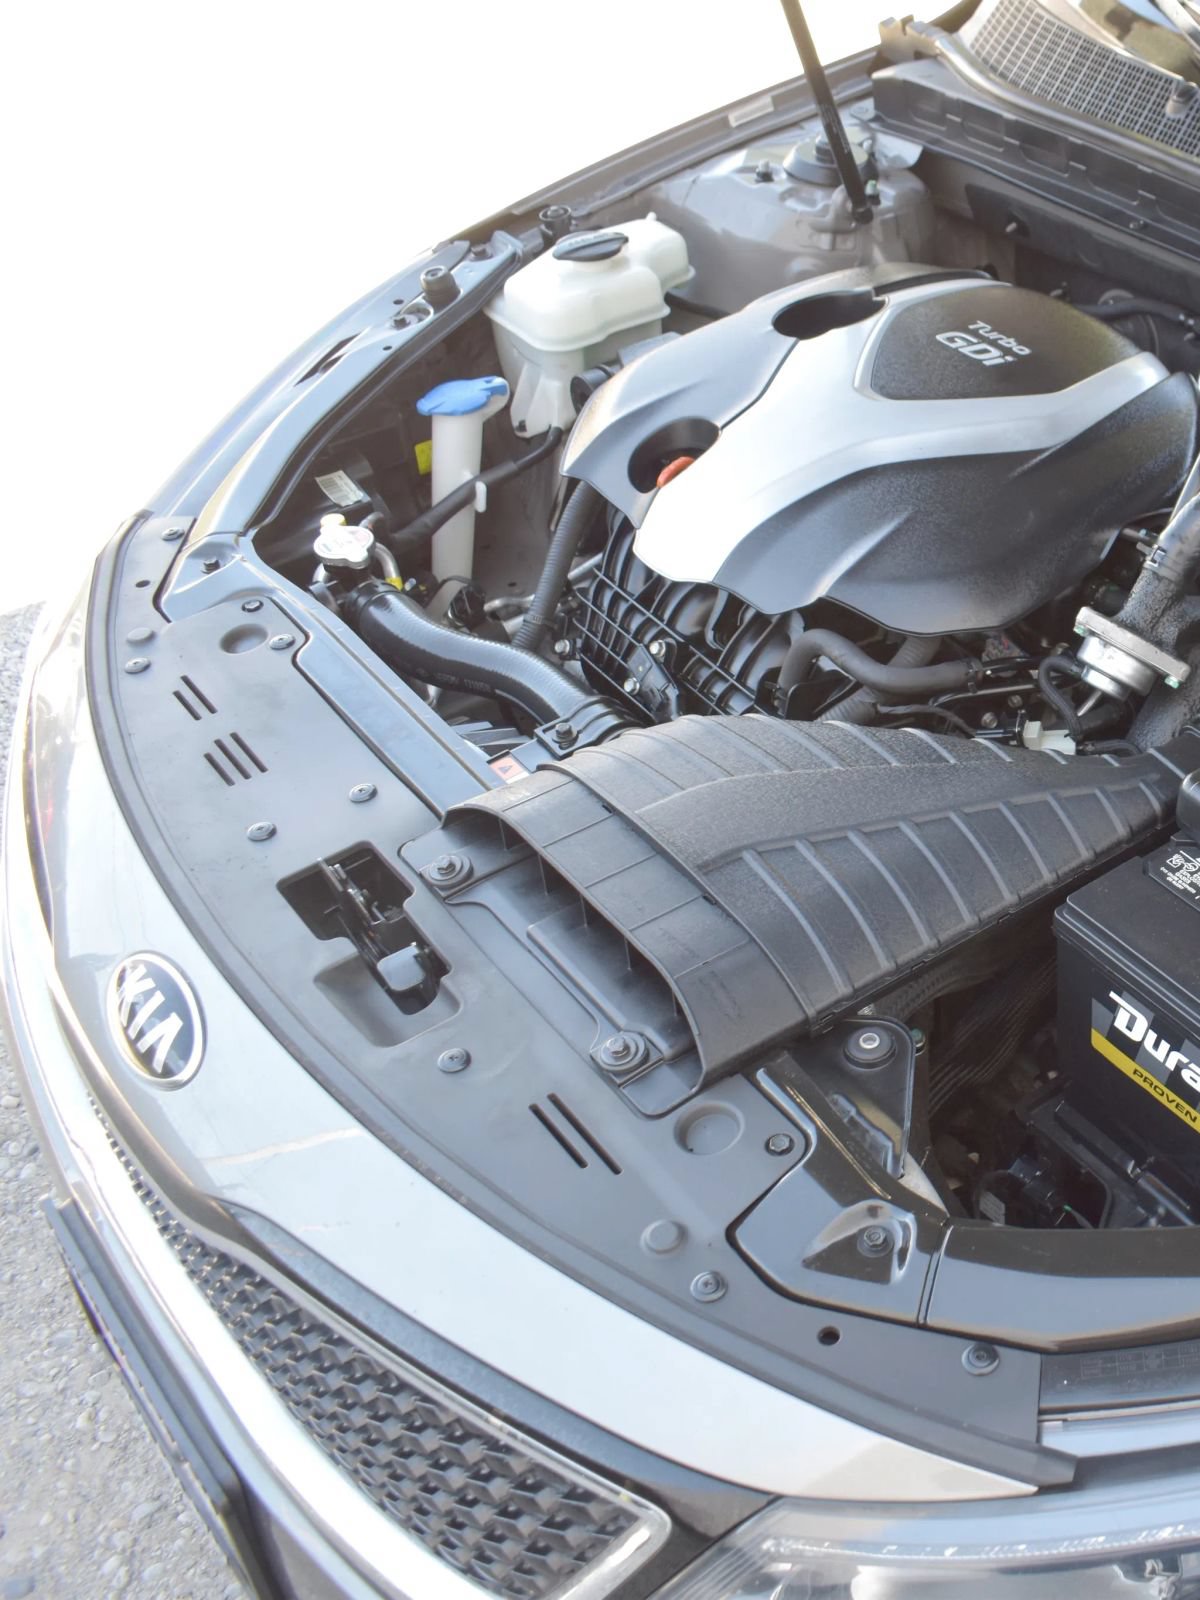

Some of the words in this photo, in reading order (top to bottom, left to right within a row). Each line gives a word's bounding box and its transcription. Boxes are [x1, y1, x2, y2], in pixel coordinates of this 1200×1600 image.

[936, 331, 1016, 366] GDi
[968, 320, 1031, 355] Turbo
[118, 963, 184, 1074] KIA
[1132, 1069, 1198, 1123] PROVEN
